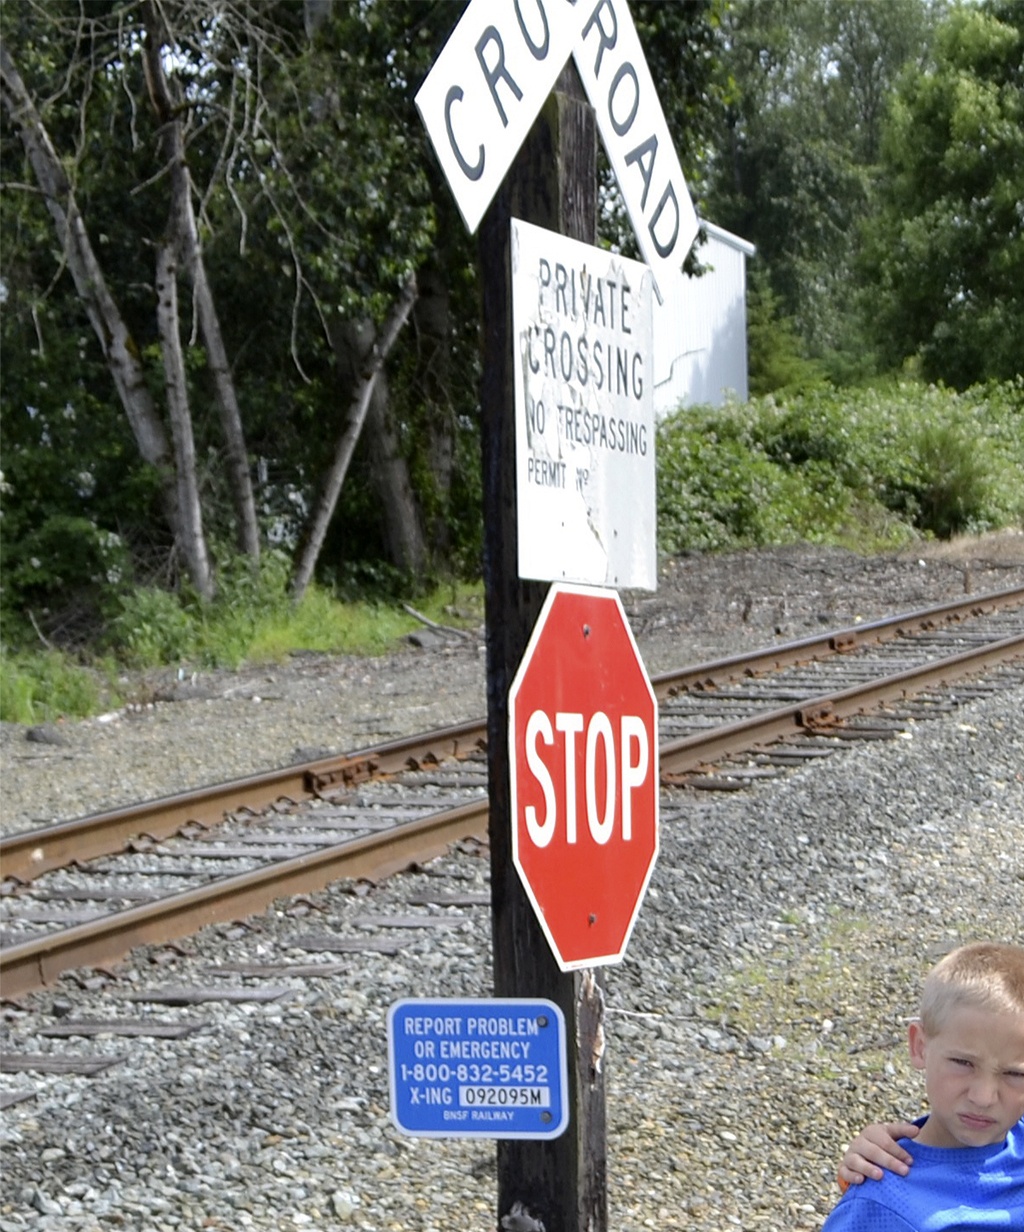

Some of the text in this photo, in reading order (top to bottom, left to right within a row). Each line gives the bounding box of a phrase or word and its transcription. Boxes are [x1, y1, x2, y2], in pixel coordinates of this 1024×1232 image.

[539, 258, 632, 334] PRIVATE
[528, 325, 643, 401] CROSSING
[557, 404, 648, 457] TRESPASSING
[527, 457, 567, 489] PERMIT
[525, 709, 649, 848] STOP
[404, 1017, 538, 1036] REPORT PROBLEM
[414, 1040, 531, 1059] OR EMERGENCY
[400, 1064, 548, 1083] 1-800-832-5452
[410, 1086, 542, 1105] X-ING 092095M
[443, 1110, 514, 1121] BNSF RAILWAY
